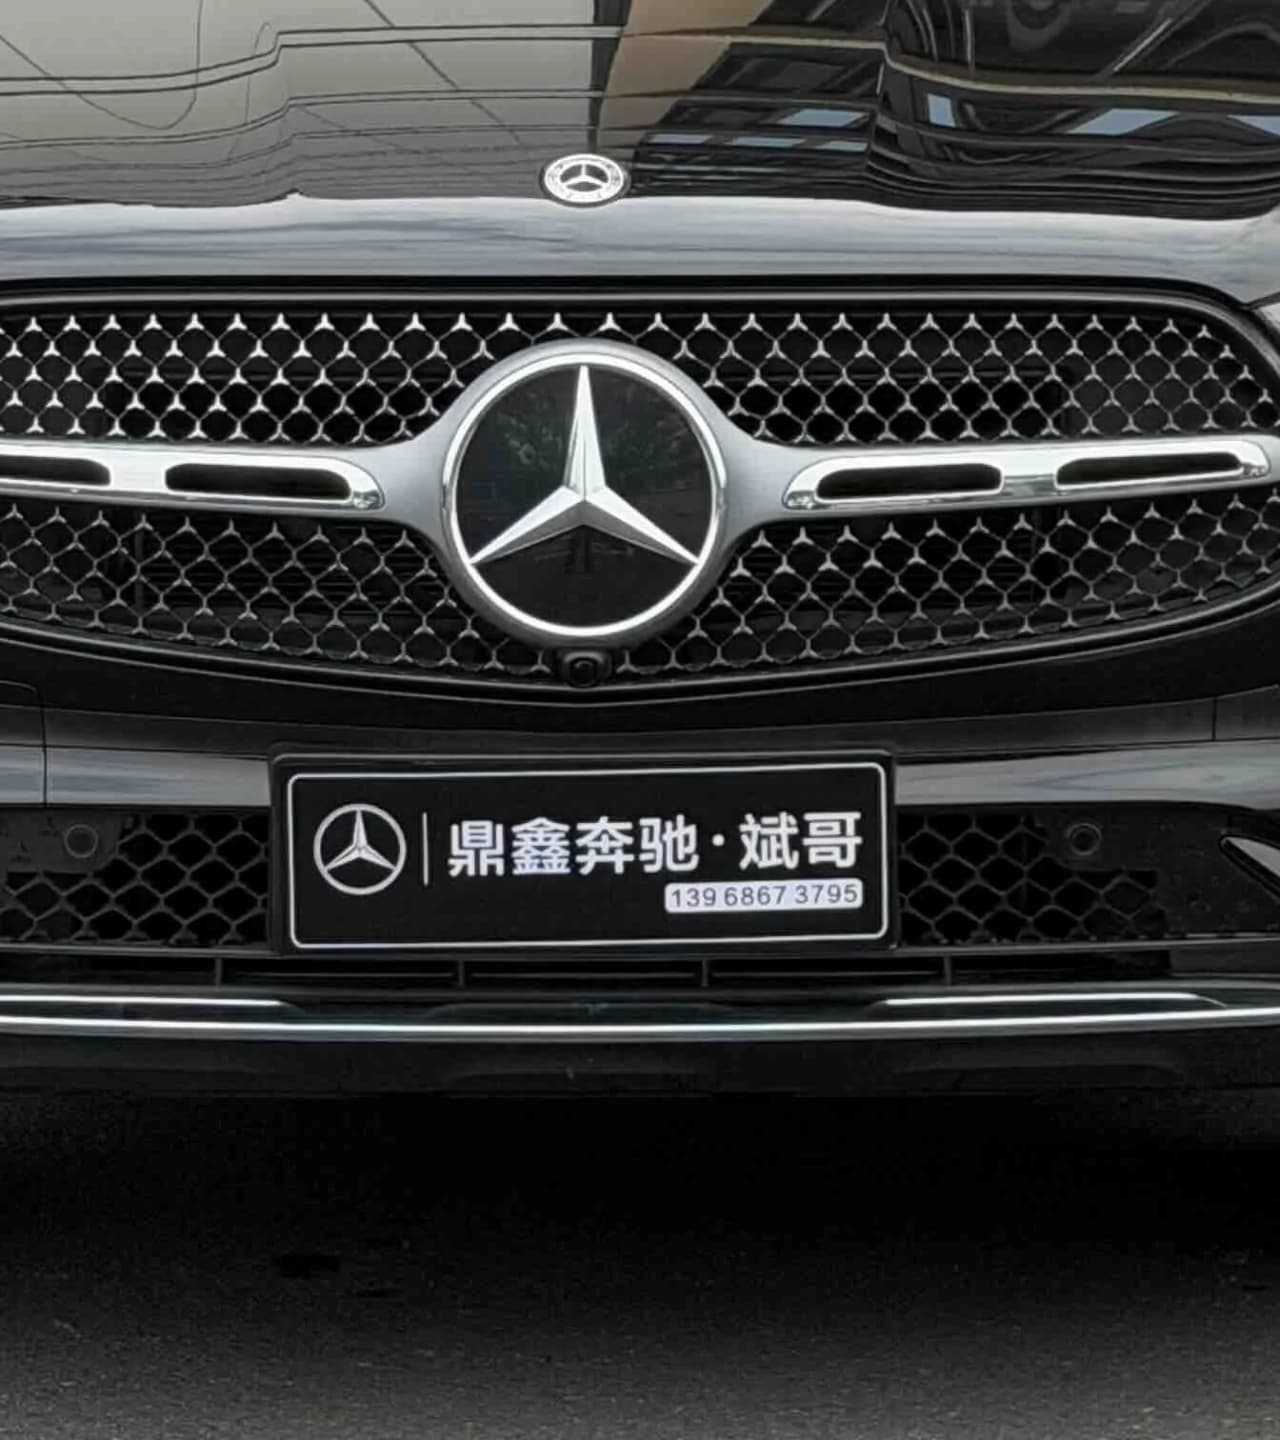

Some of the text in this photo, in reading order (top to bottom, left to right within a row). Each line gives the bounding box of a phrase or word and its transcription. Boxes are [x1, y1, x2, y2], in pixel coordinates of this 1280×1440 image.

[448, 811, 864, 878] 鼎鑫奔驰·斌哥
[671, 883, 859, 908] 139 6867 3795
